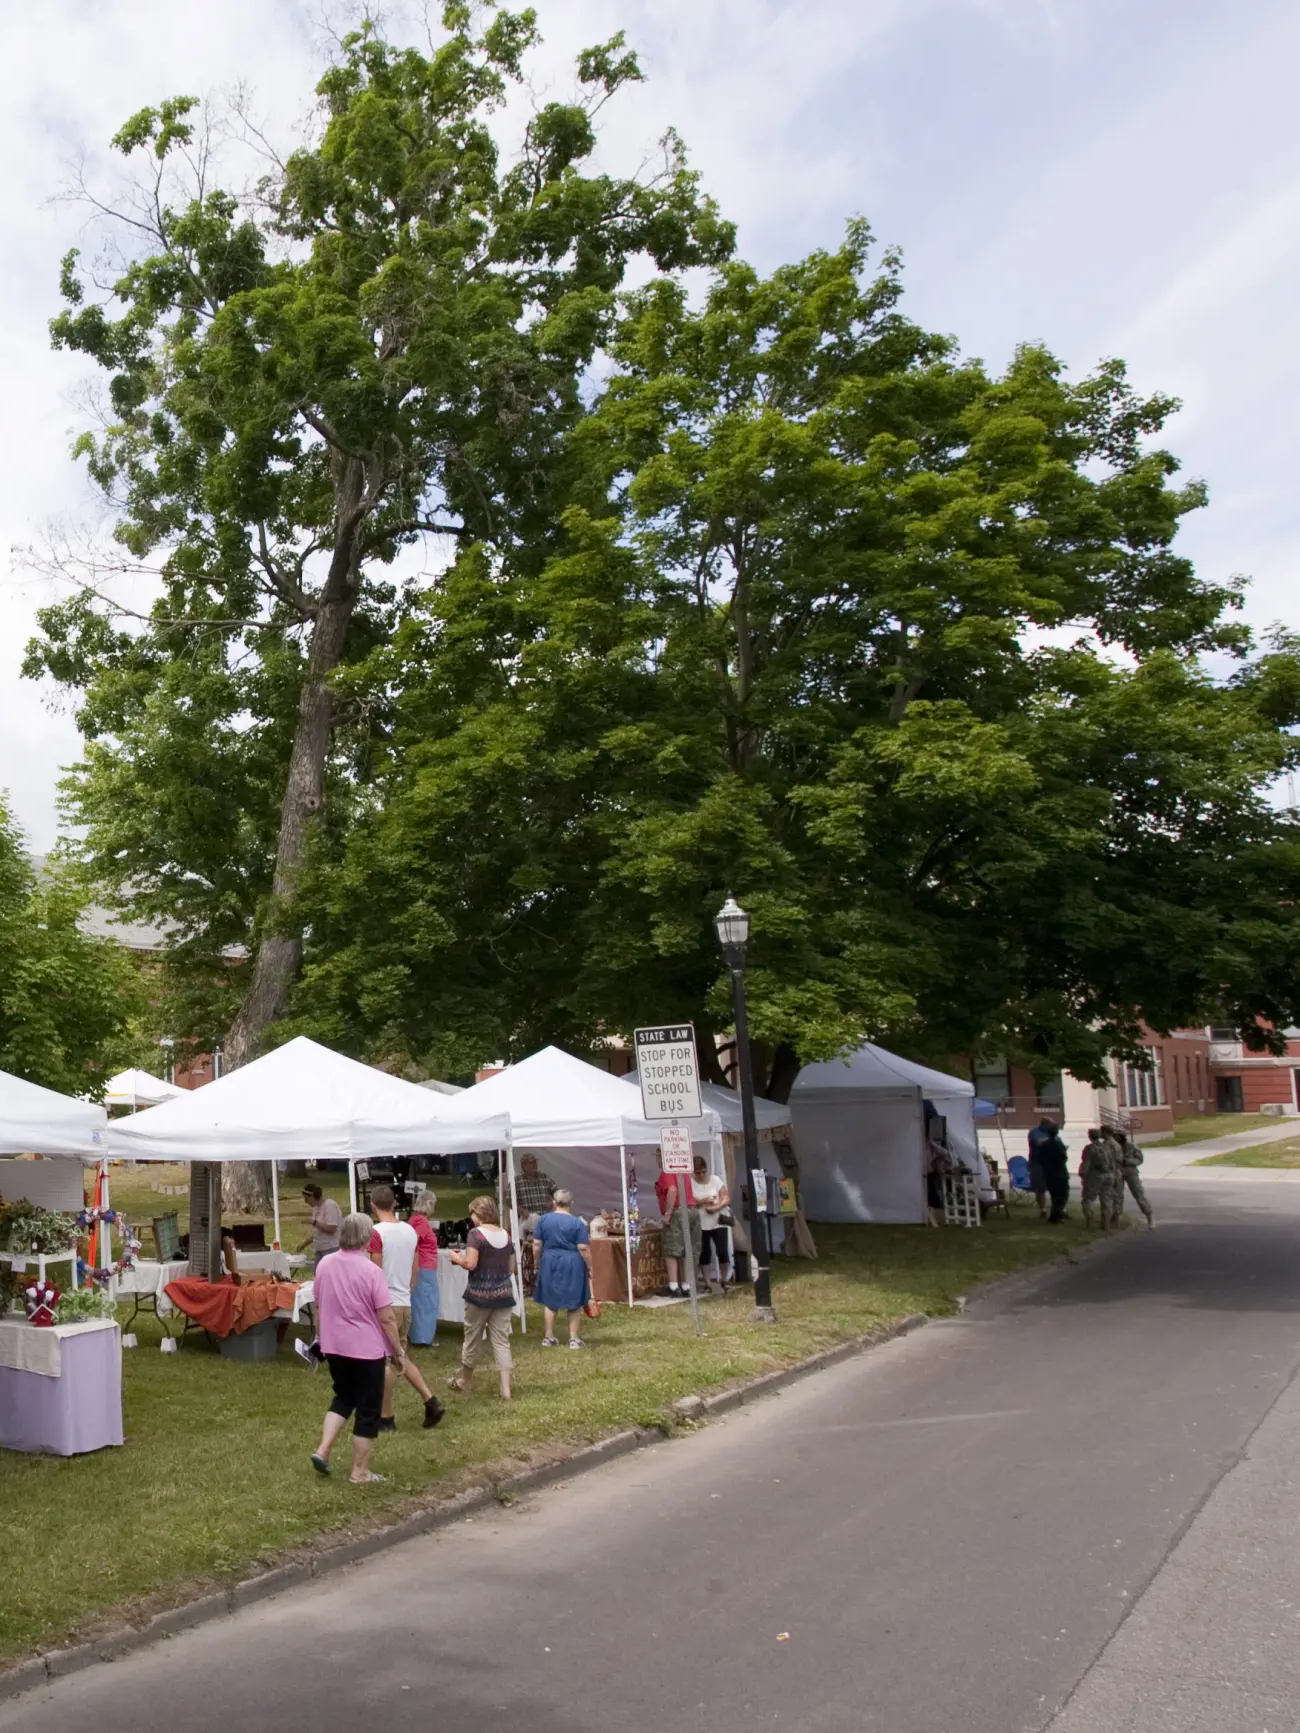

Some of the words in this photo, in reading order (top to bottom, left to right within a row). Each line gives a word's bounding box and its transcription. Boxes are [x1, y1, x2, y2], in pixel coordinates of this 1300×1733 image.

[639, 1031, 665, 1042] STATE
[670, 1029, 688, 1040] LAW
[640, 1049, 666, 1062] STOP
[670, 1047, 691, 1060] FOR
[644, 1065, 693, 1078] STOPPED
[647, 1082, 692, 1095] SCHOOL
[660, 1099, 684, 1112] BUS
